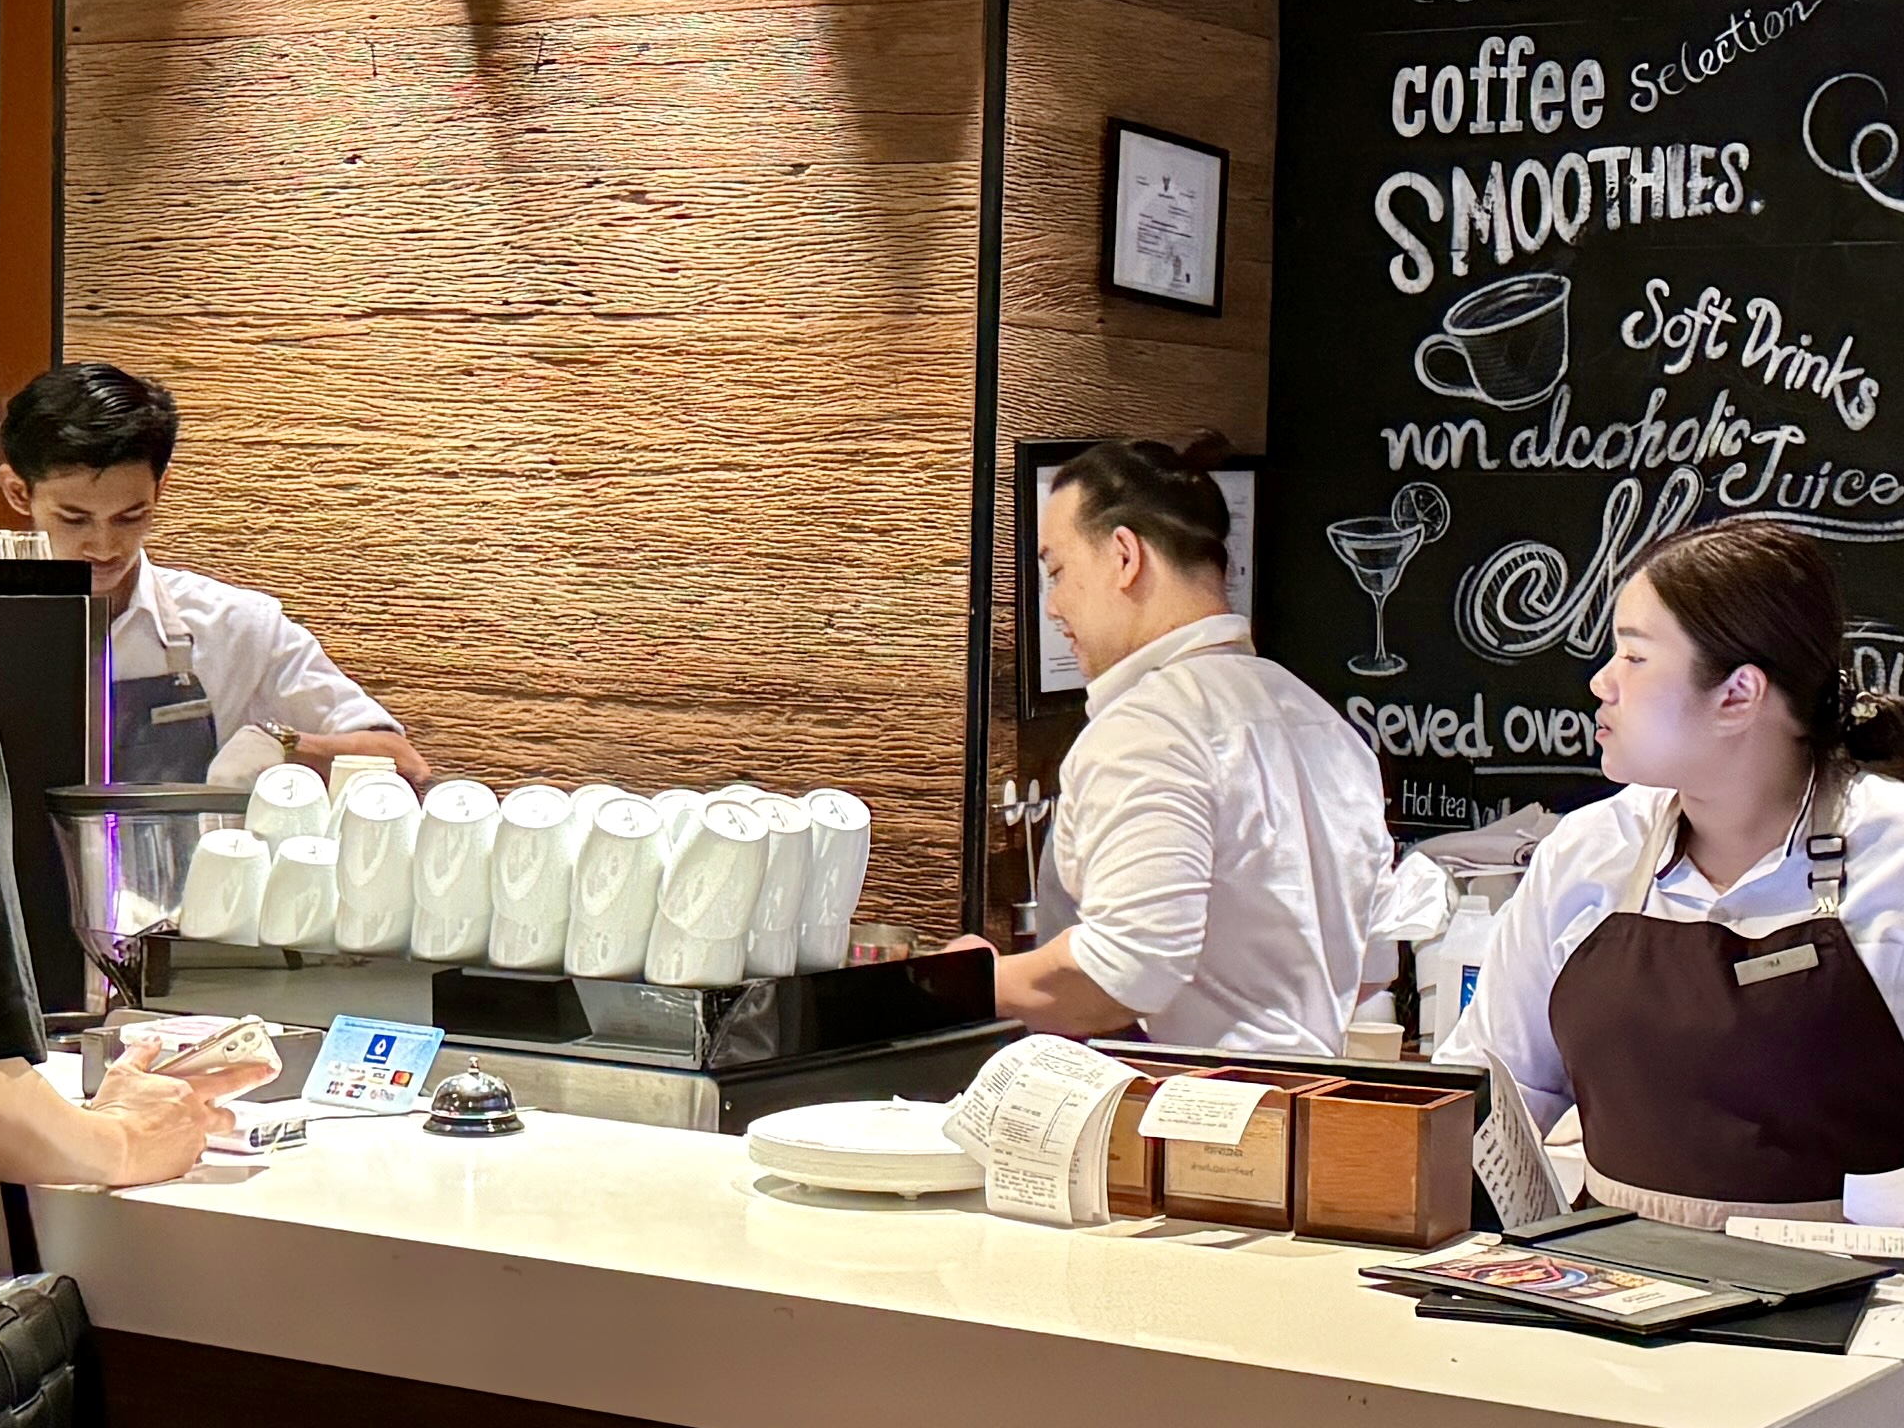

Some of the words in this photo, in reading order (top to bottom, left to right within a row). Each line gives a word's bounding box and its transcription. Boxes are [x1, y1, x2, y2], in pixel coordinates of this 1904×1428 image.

[1390, 35, 1606, 138] coffee
[1621, 277, 1738, 374] Soft
[1741, 296, 1881, 432] Drinks
[1380, 417, 1501, 474] non
[1507, 384, 1752, 472] alcoholic
[1440, 783, 1467, 819] tea
